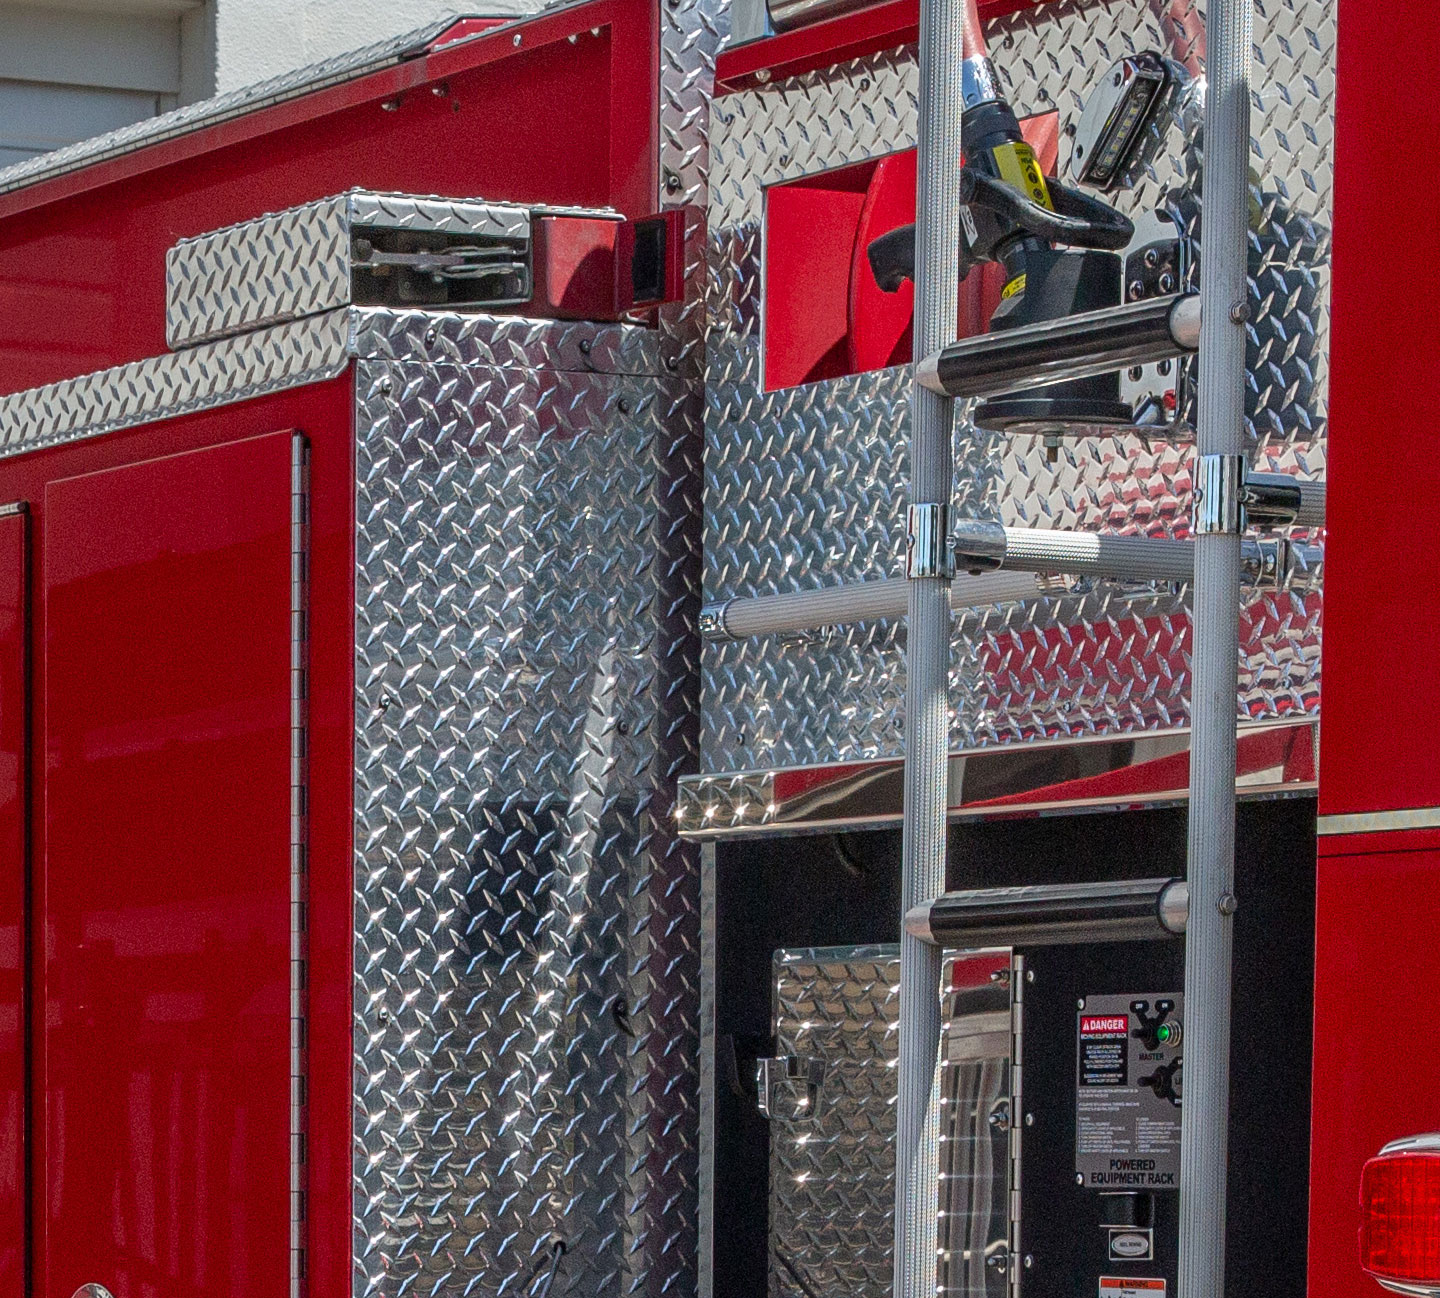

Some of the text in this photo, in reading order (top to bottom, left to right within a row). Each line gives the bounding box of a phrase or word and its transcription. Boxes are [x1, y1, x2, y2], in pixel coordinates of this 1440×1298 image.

[1090, 1019, 1124, 1030] DANGER
[1138, 1052, 1164, 1060] MASTER
[1110, 1159, 1156, 1170] POWERED
[1091, 1172, 1175, 1184] EQUIPMENT RACK
